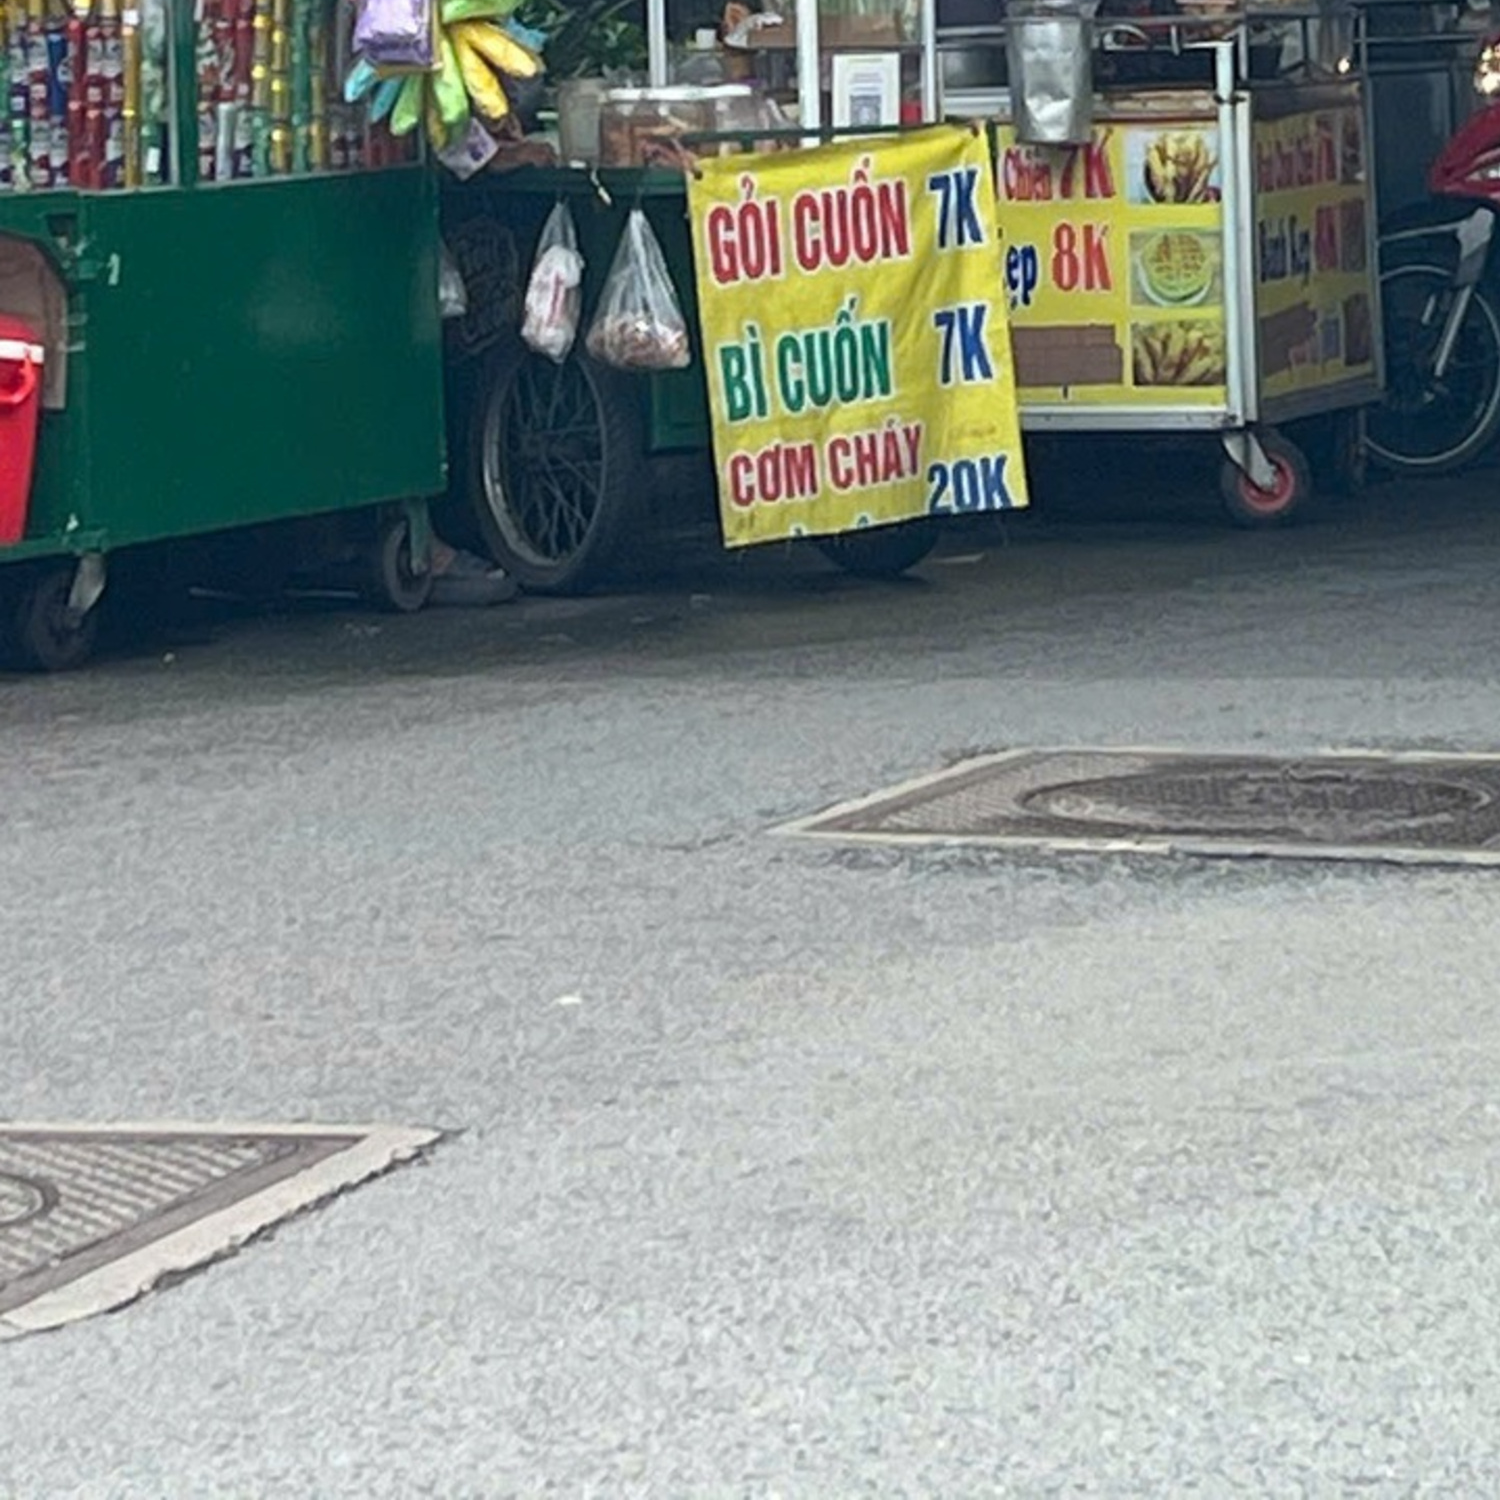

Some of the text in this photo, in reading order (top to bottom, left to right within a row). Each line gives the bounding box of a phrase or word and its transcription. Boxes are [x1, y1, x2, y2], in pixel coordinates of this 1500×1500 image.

[707, 156, 985, 284] GỎI CUỐN 7K
[1051, 221, 1113, 292] 8K
[719, 296, 994, 423] BÌ CUỐN 7K
[729, 418, 1013, 514] CƠM CHÁY 20K
